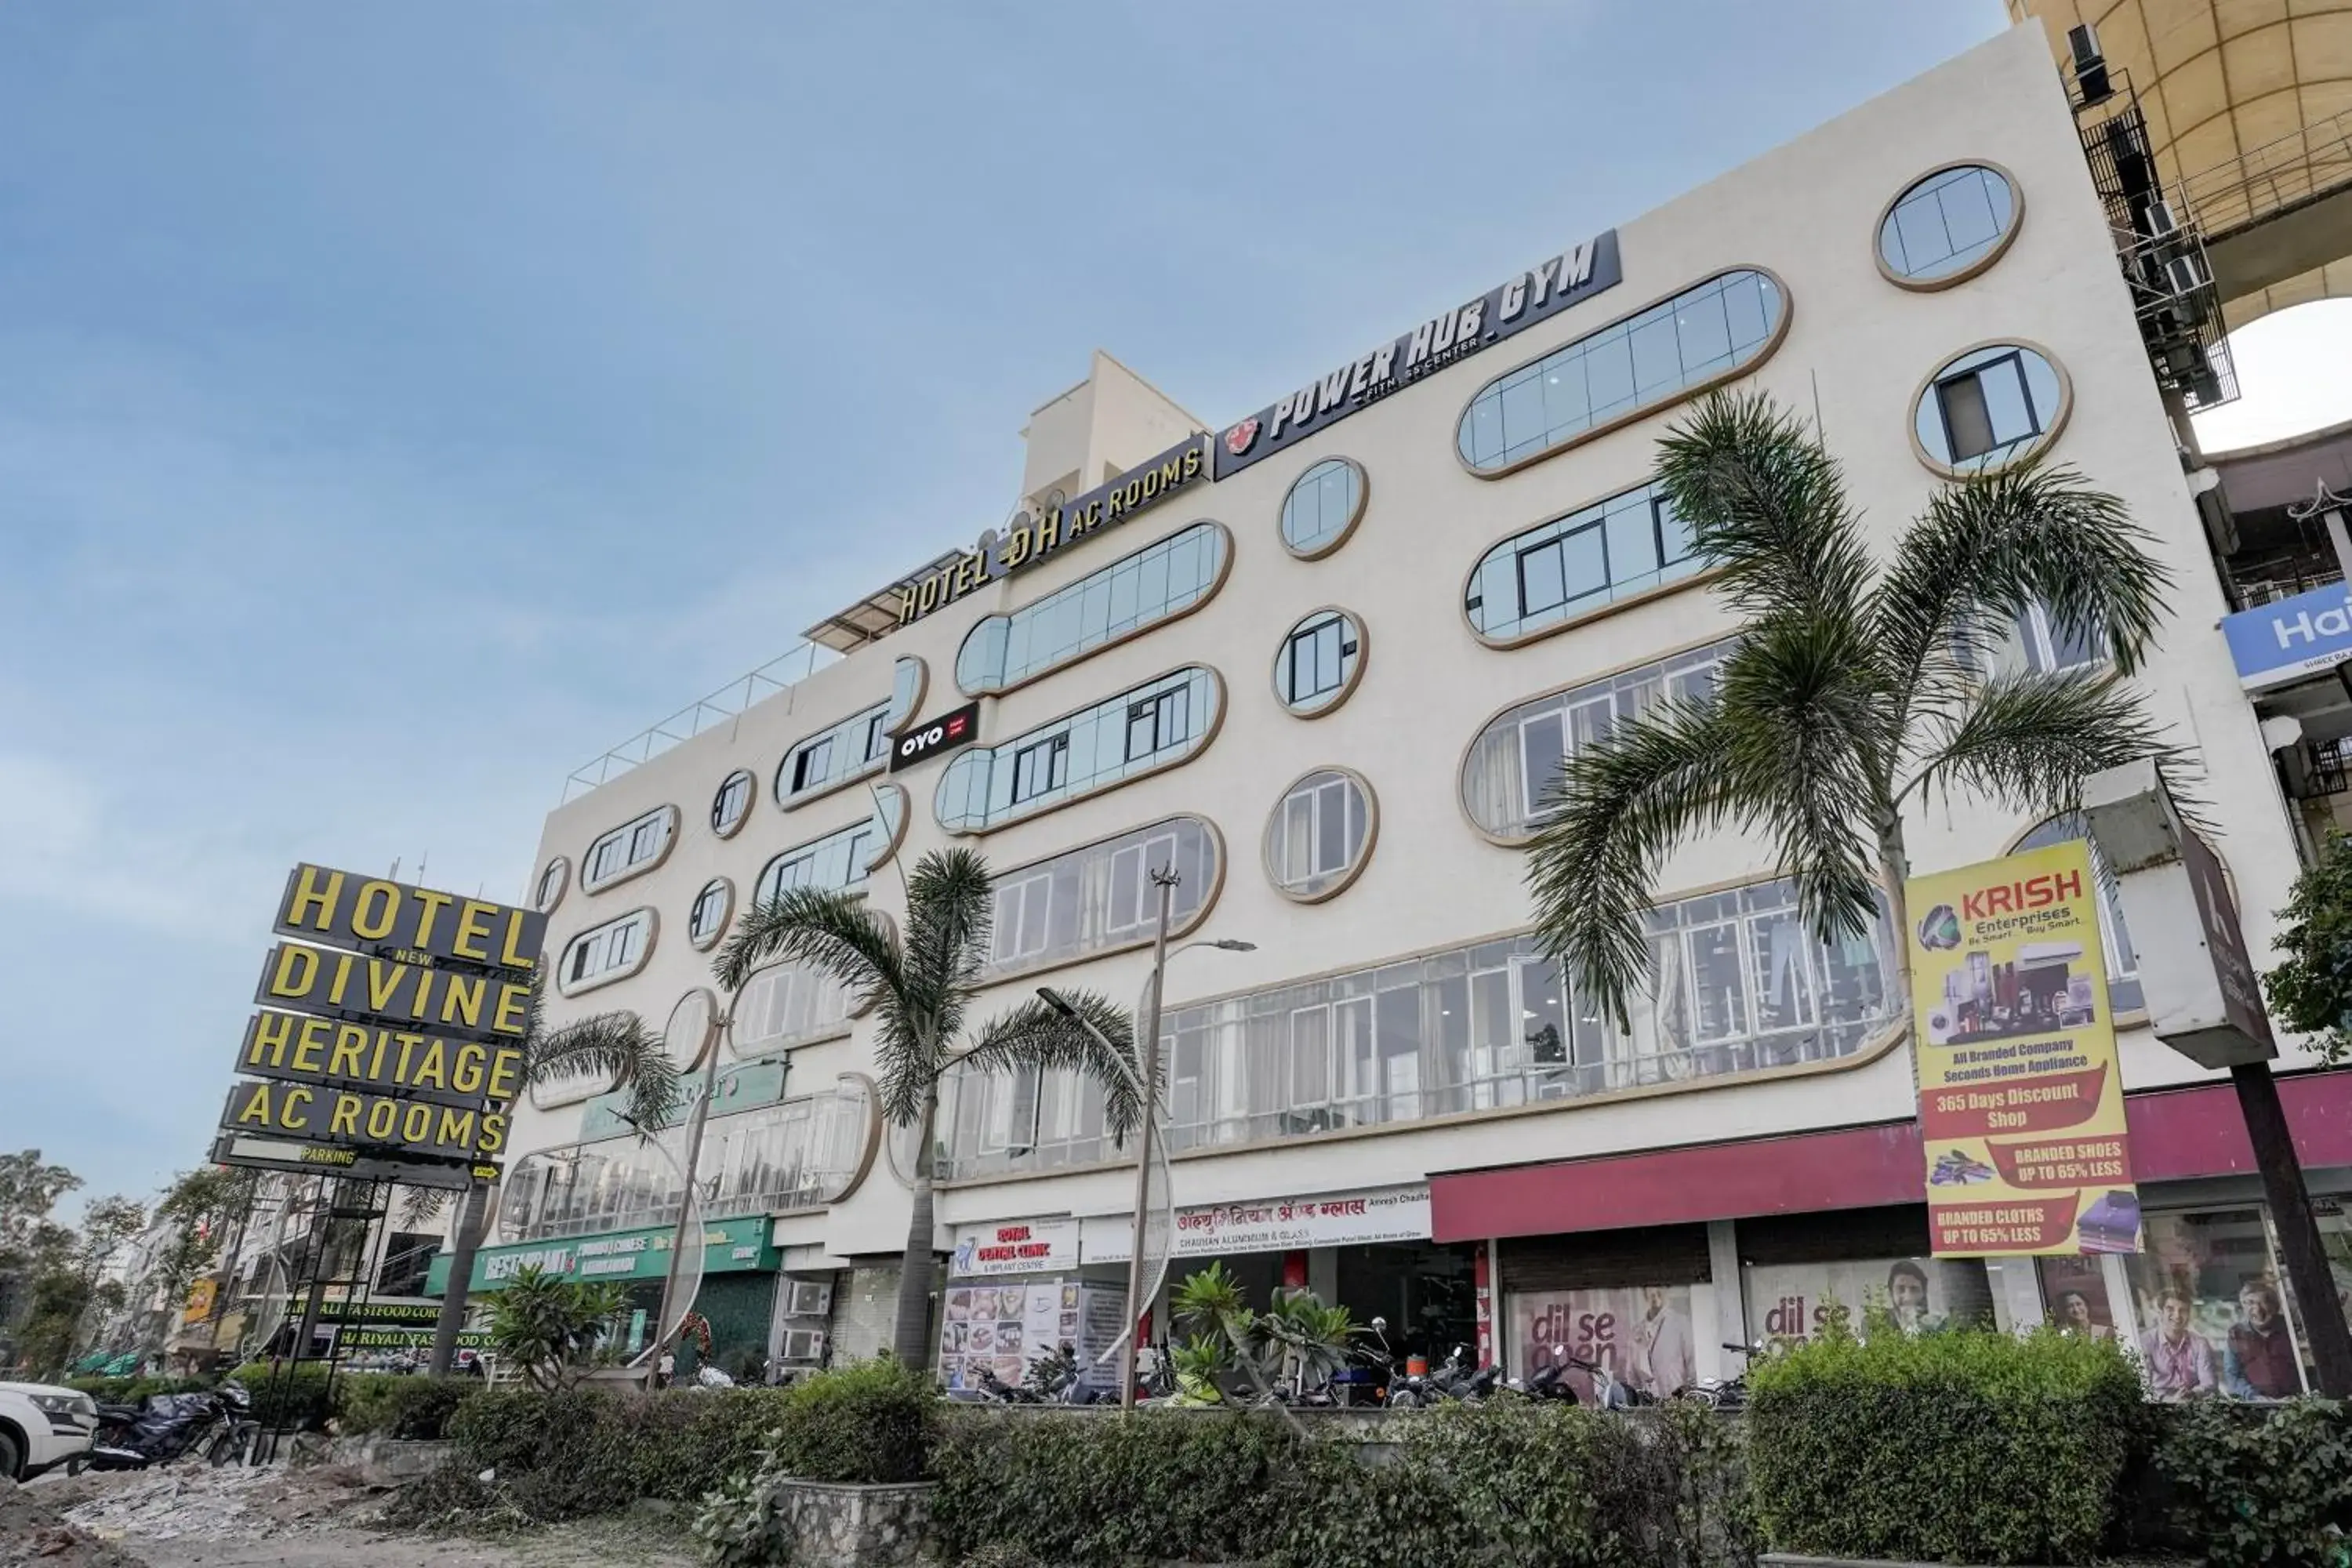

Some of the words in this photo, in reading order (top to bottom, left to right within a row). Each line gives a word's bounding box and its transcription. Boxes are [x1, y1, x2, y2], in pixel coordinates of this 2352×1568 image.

[1269, 342, 1401, 439] POWER
[1406, 299, 1489, 367] HUB
[1499, 238, 1598, 322] GYM
[1367, 366, 1421, 398] FITNSS
[1425, 337, 1478, 370] CENTER
[899, 550, 991, 625] HOTEL
[1069, 500, 1102, 539] AC
[1109, 448, 1203, 519] ROOMS
[901, 727, 943, 756] OYO
[1962, 869, 2082, 920] KRISH
[286, 866, 535, 969] HOTEL
[1976, 906, 2071, 934] Enterprises
[2027, 925, 2045, 935] Buy
[395, 949, 432, 966] NEW
[270, 945, 532, 1033] DIVINE
[248, 1013, 521, 1098] HERITAGE
[1953, 1052, 1967, 1065] All
[1969, 1046, 2016, 1062] Branded
[2019, 1039, 2074, 1056] Company
[1944, 1067, 1991, 1082] Seconds
[1993, 1064, 2025, 1077] Home
[2027, 1054, 2088, 1073] Appliance
[1936, 1095, 1965, 1112] 365
[1969, 1092, 2005, 1109] Days
[2008, 1082, 2079, 1105] Discount
[239, 1084, 313, 1128] AC
[331, 1094, 506, 1152] ROOMS
[1988, 1110, 2027, 1128] Shop
[300, 1147, 355, 1165] PARKING
[2014, 1145, 2075, 1164] BRANDED
[2078, 1142, 2122, 1159] SHOES
[2018, 1167, 2036, 1182] UP
[2038, 1166, 2054, 1180] TO
[2058, 1163, 2088, 1178] 65%
[2091, 1161, 2123, 1177] LESS
[1937, 1210, 1994, 1226] BRANDED
[1995, 1208, 2045, 1224] CLOTHS
[1944, 1230, 1959, 1244] UP
[1962, 1229, 1977, 1243] TO
[1980, 1228, 2009, 1243] 65%
[2011, 1227, 2042, 1242] LESS
[1018, 1259, 1044, 1270] CENTRE
[1532, 1304, 1570, 1343] dil
[1577, 1313, 1615, 1341] se
[1766, 1296, 1804, 1334] dil
